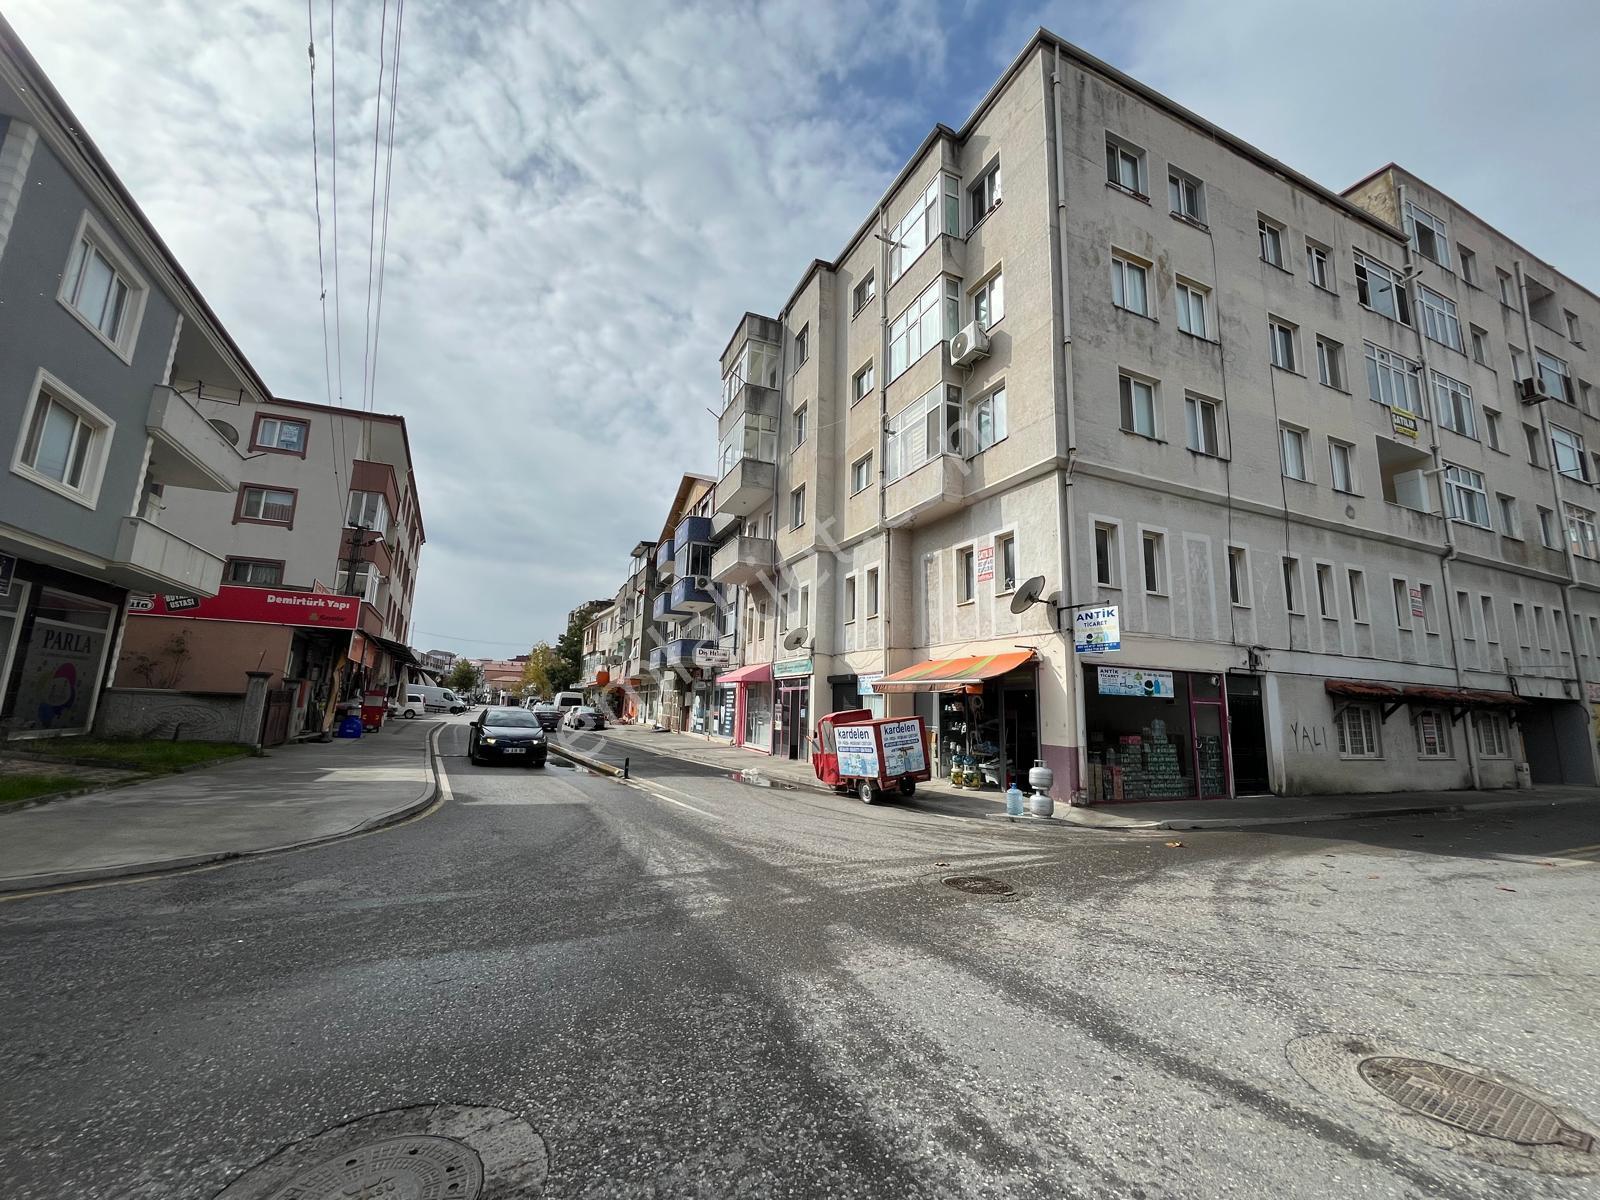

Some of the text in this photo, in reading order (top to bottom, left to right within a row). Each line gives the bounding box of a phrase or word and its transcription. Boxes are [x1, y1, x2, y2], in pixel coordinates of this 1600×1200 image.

[266, 594, 350, 610] Demirtürk Yapı
[1076, 609, 1115, 621] ANTİK
[1084, 620, 1107, 628] TİCARET
[42, 629, 91, 653] PARLA
[837, 728, 870, 739] kardelen
[884, 723, 915, 735] kardelen
